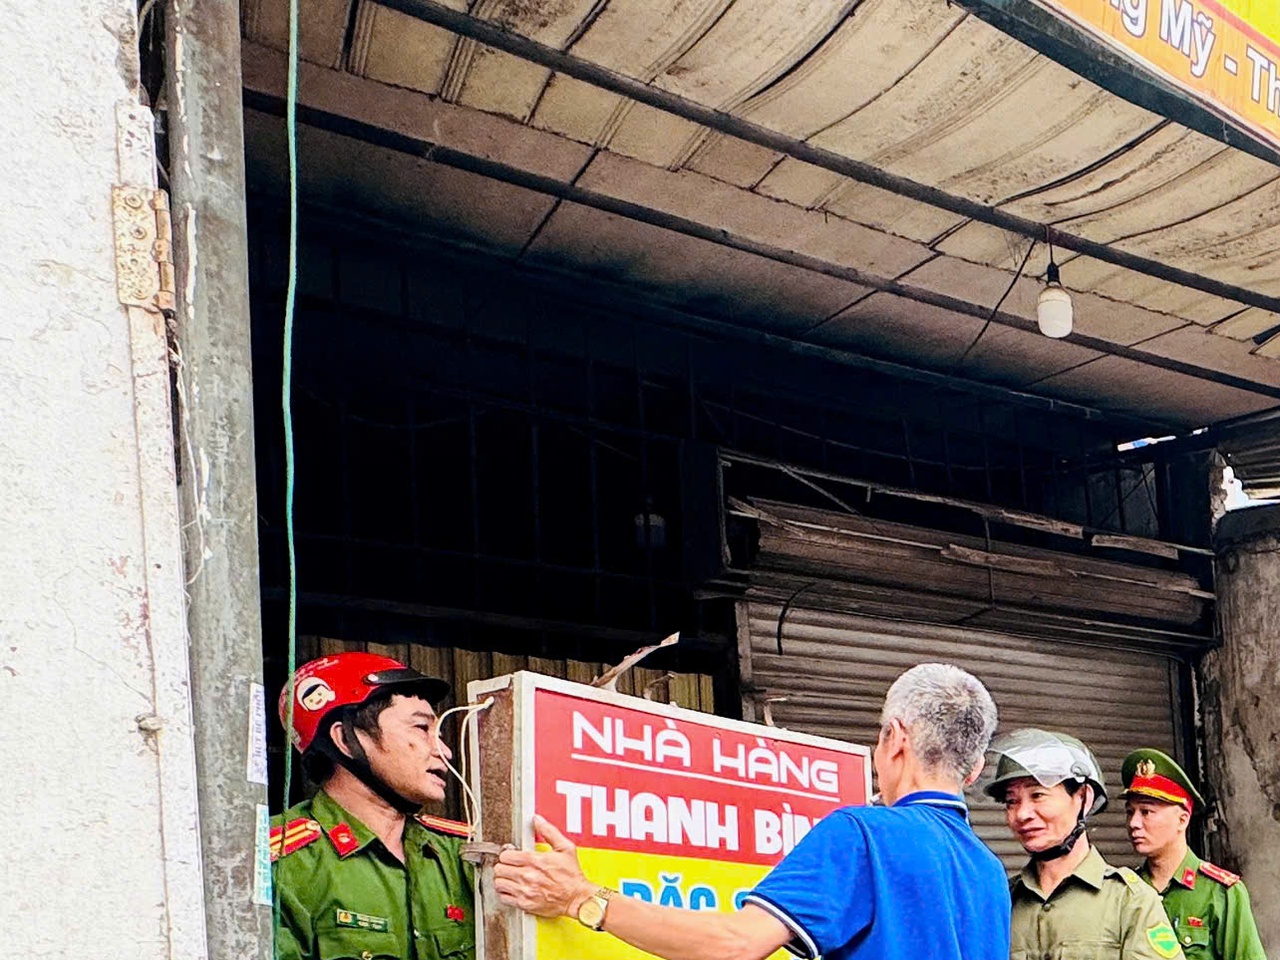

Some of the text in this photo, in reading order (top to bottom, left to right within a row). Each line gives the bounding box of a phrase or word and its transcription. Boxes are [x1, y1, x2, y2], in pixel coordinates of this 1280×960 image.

[1159, 0, 1216, 78] Mỹ
[572, 711, 839, 792] NHÀ HÀNG
[556, 780, 740, 851] THANH
